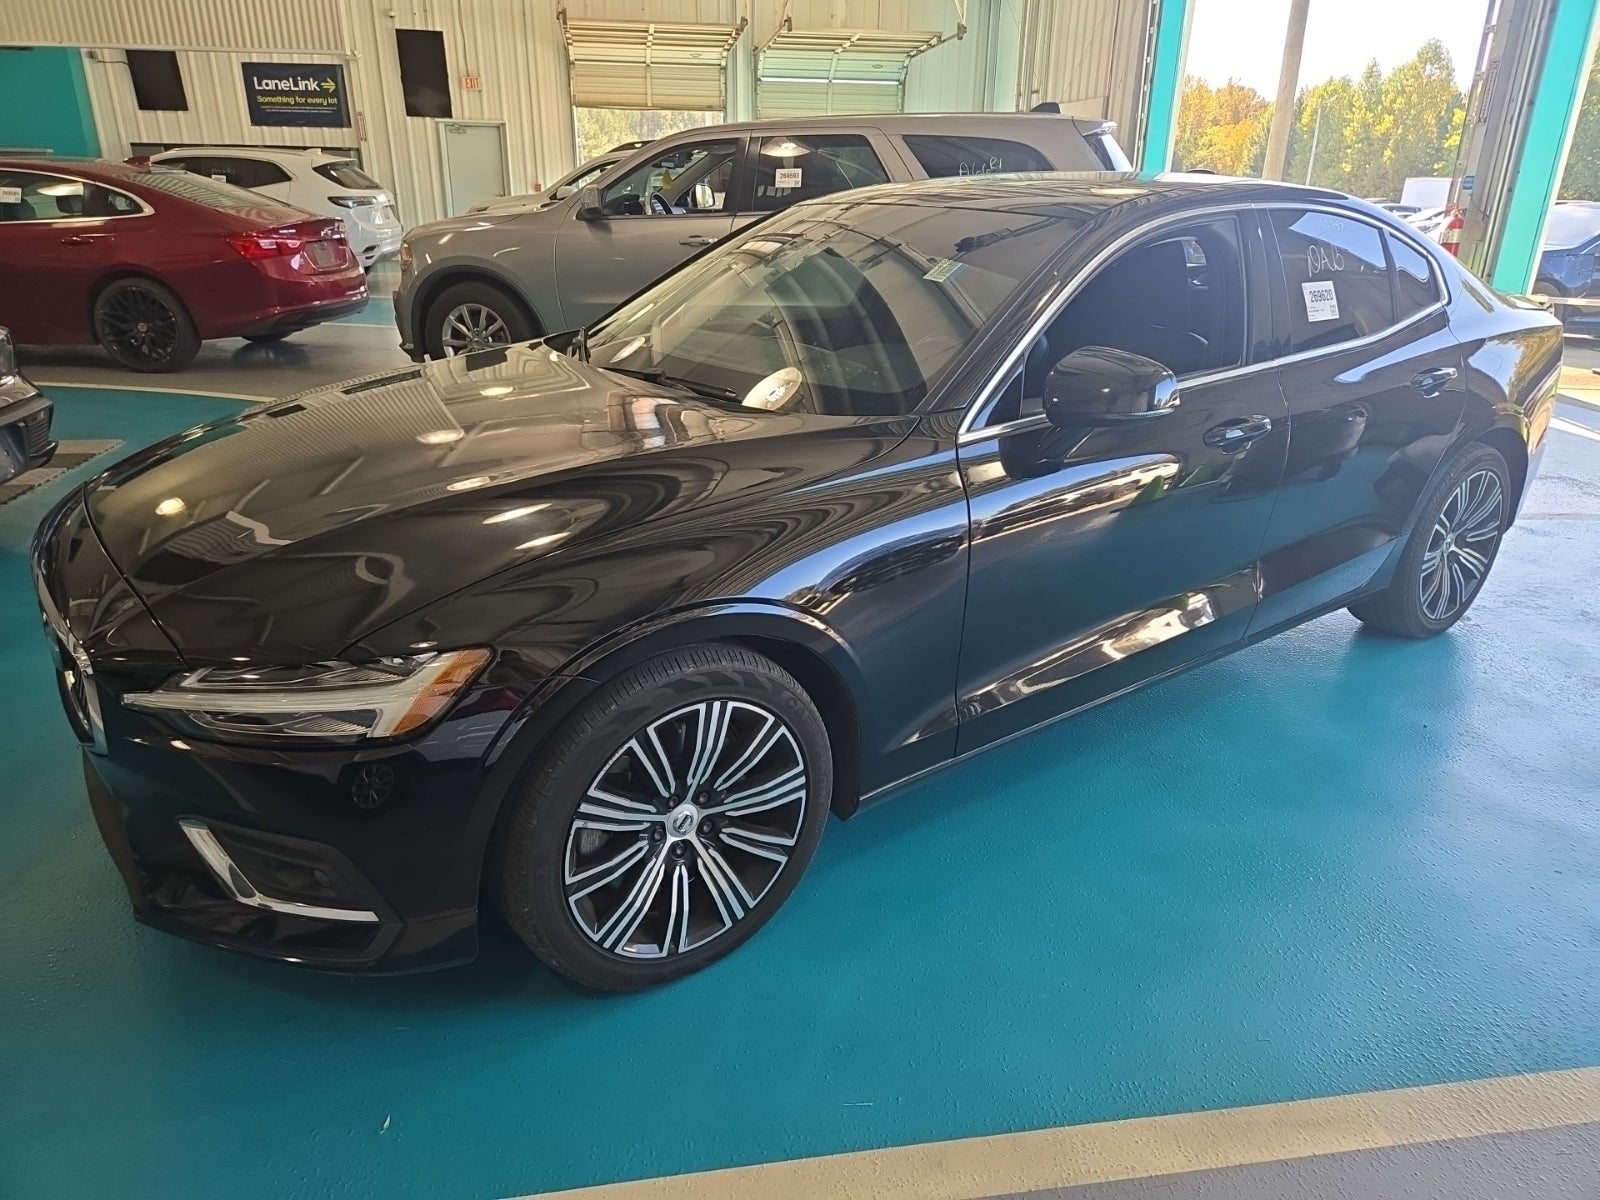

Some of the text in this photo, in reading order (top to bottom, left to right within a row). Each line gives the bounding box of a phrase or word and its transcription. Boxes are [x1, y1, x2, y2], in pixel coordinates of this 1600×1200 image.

[253, 76, 320, 91] LaneLink
[465, 77, 479, 89] EXIT
[257, 95, 295, 105] Something
[295, 96, 307, 104] for
[307, 97, 328, 106] every
[1309, 288, 1334, 302] 269620
